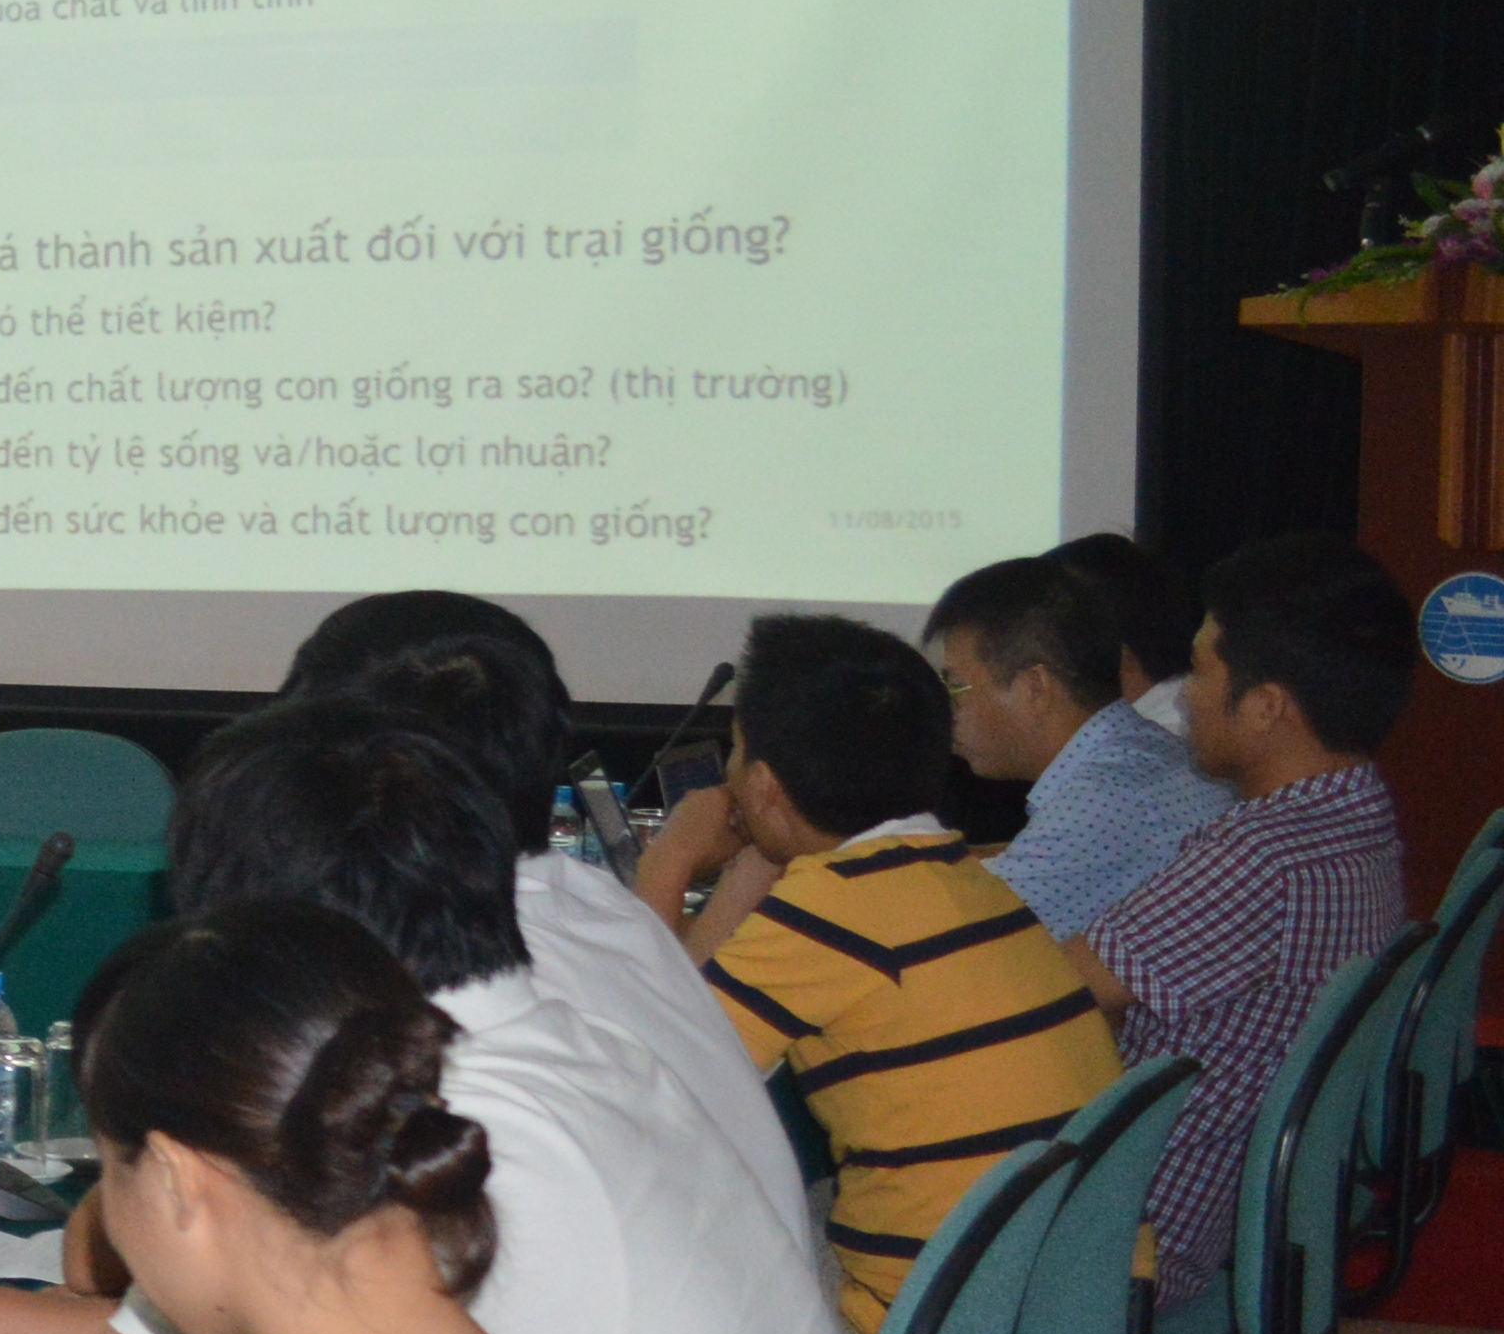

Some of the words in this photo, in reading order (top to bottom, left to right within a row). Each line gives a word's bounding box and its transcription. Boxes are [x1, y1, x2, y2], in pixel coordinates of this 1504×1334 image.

[36, 230, 152, 270] thành
[168, 222, 238, 268] sản
[255, 215, 349, 265] xuất
[367, 215, 437, 263] đối
[454, 220, 525, 261] với
[545, 220, 623, 267] trại
[640, 206, 790, 266] giống?
[31, 296, 87, 336] thể
[100, 294, 162, 335] tiết
[176, 300, 277, 341] kiệm?
[67, 365, 142, 404] chất
[157, 371, 262, 410] lượng
[276, 375, 337, 401] con
[352, 362, 452, 408] giống
[467, 374, 502, 400] ra
[517, 367, 592, 400] sao?
[609, 367, 676, 407] (thị
[692, 365, 850, 408] trường)
[114, 436, 145, 474] lệ
[159, 430, 240, 475] sống
[254, 436, 401, 475] và/hoặc
[416, 436, 467, 476] lợi
[481, 434, 612, 476] nhuận?
[67, 503, 125, 534] sức
[139, 498, 224, 535] khỏe
[239, 503, 278, 534] và
[292, 496, 370, 536] chất
[386, 504, 496, 544] lượng
[509, 509, 575, 537] con
[590, 498, 713, 547] giống?
